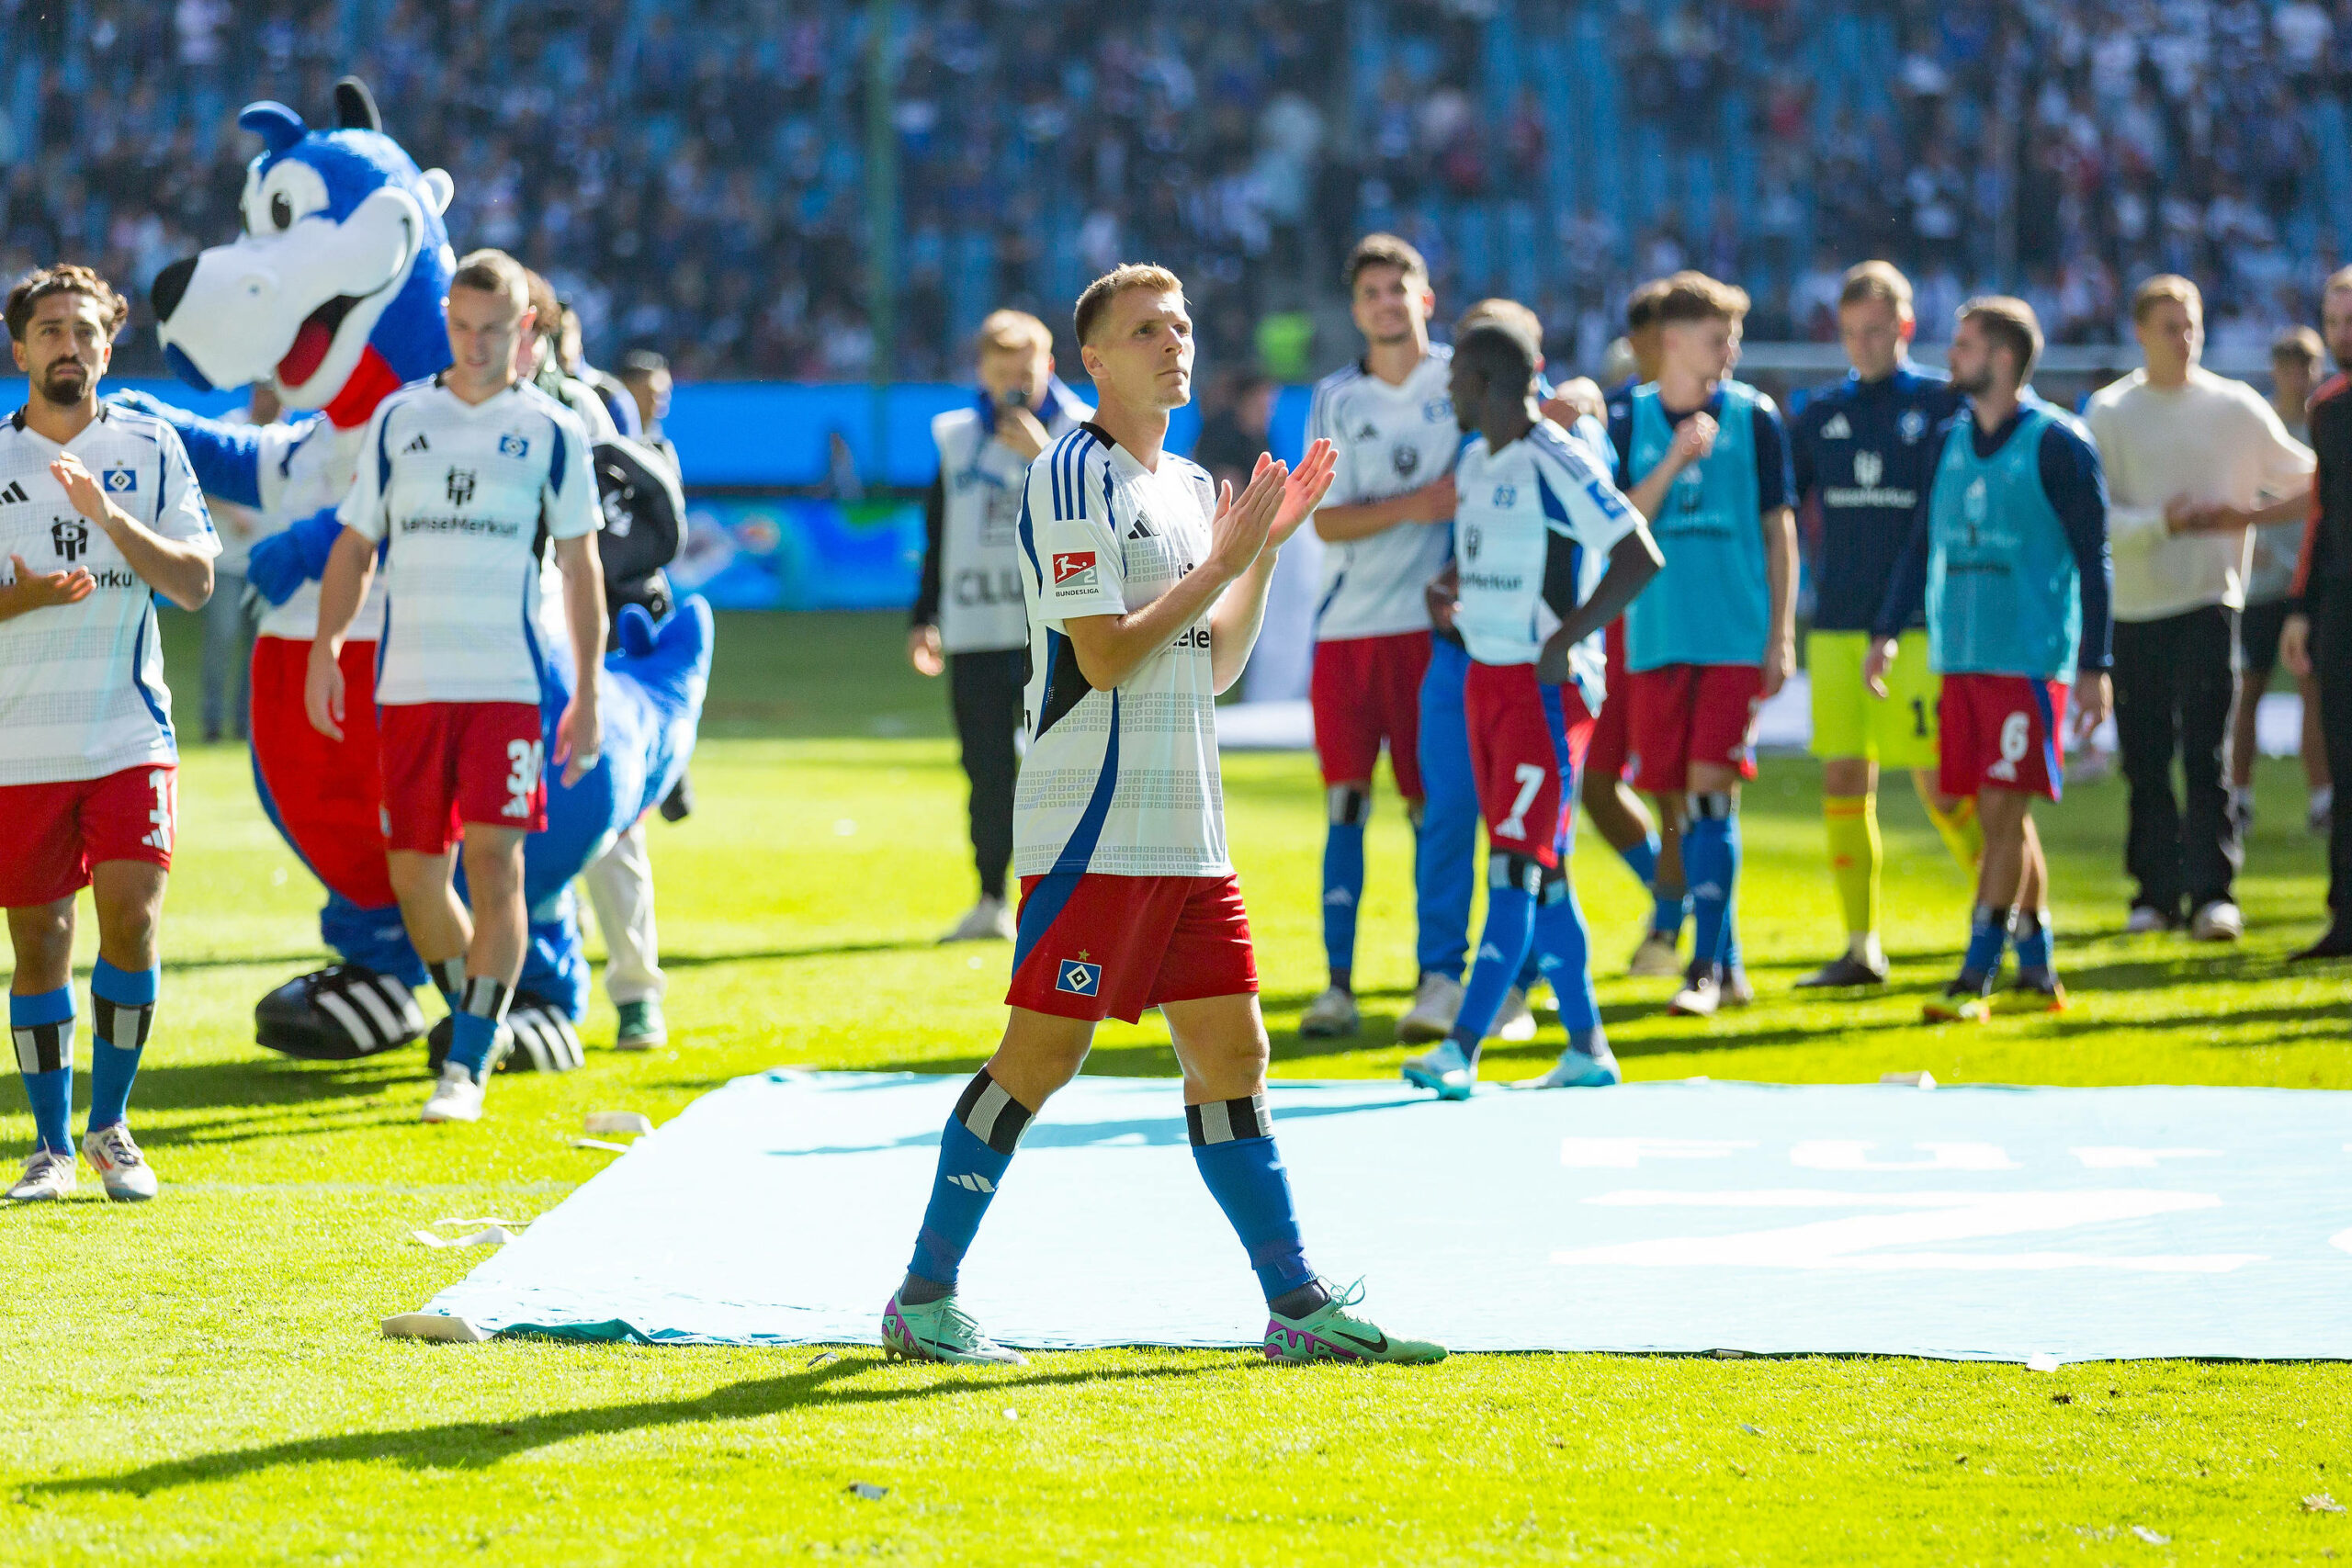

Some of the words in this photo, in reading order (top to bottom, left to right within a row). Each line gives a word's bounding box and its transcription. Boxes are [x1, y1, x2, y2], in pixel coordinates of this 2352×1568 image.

[1056, 588, 1099, 597] BUNDESLIGA
[2000, 711, 2030, 763] 6
[1510, 762, 1545, 818] 7
